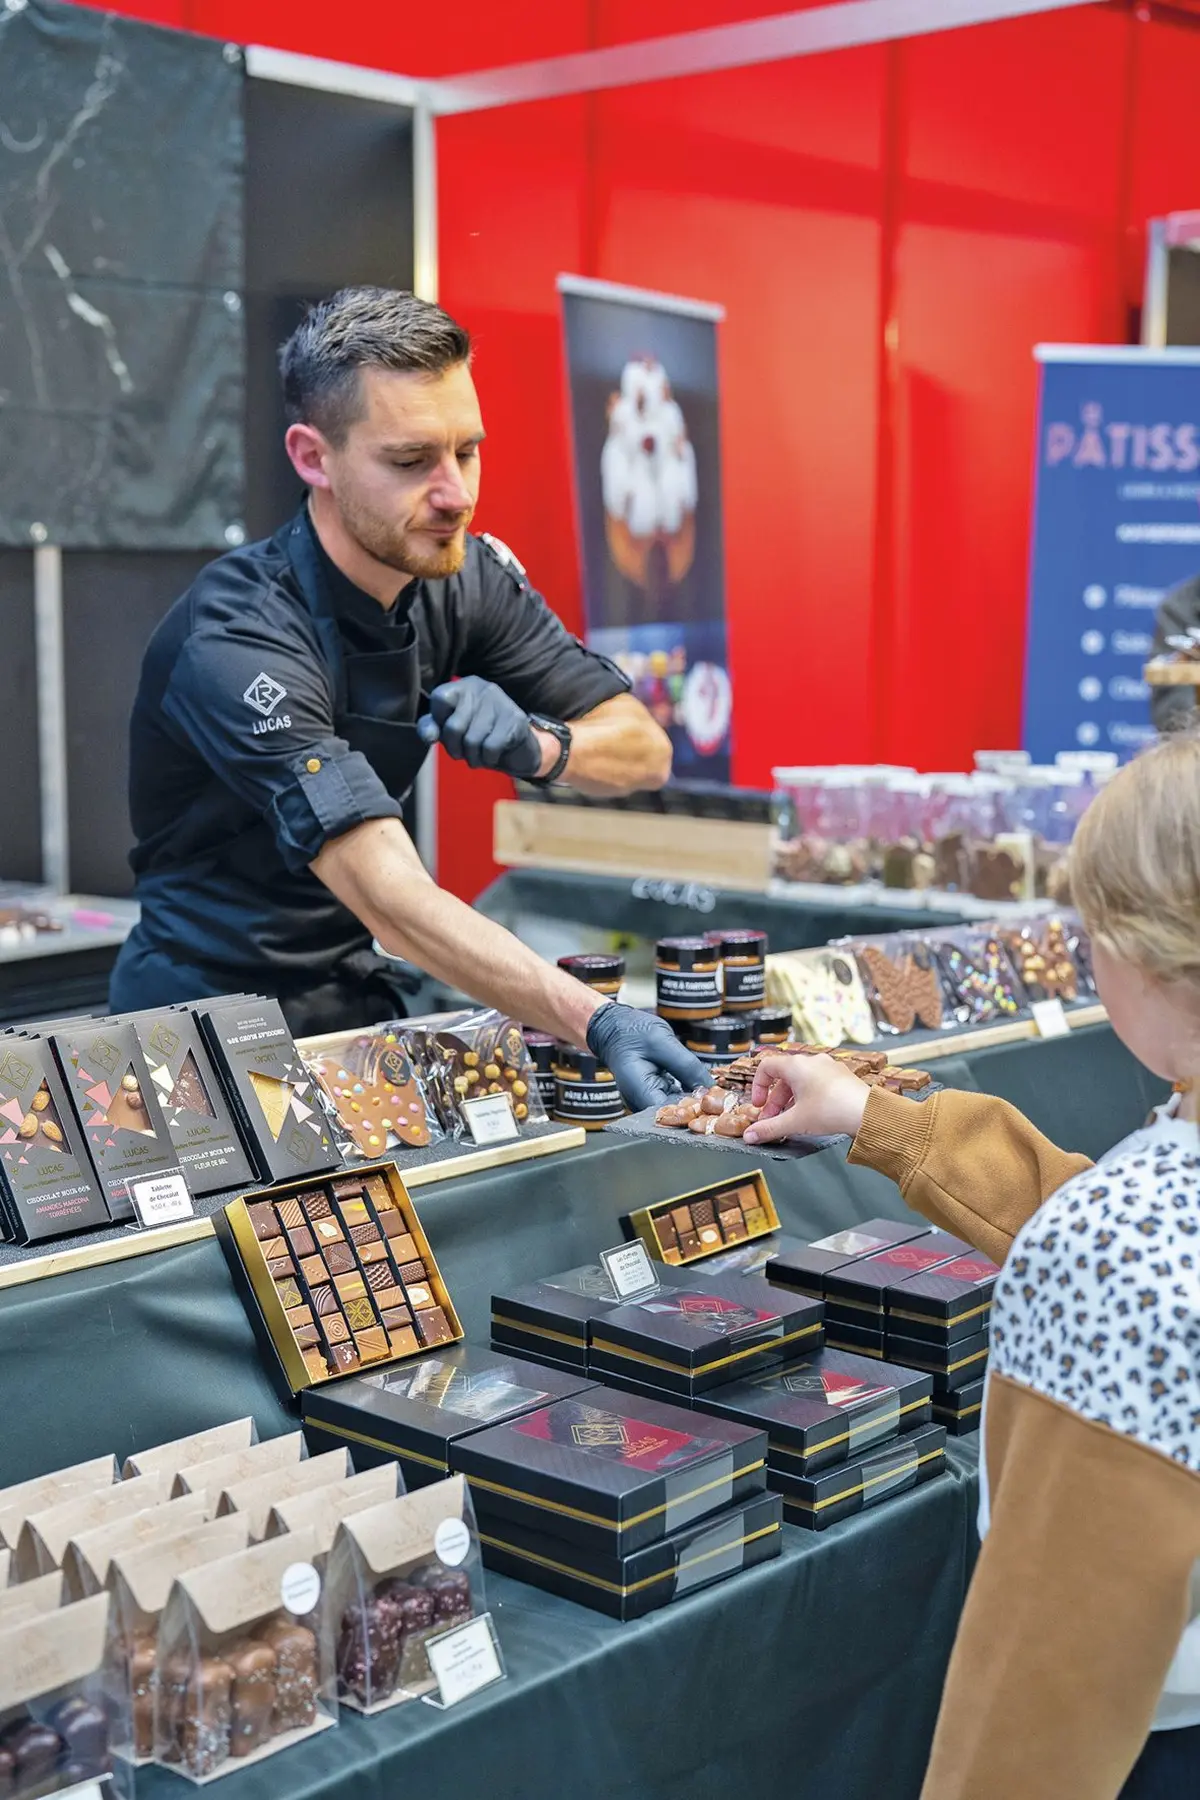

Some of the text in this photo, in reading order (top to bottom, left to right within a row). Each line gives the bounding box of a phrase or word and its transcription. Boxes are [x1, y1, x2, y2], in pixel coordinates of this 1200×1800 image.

[252, 714, 292, 735] LUCAS
[123, 1145, 150, 1158] LUCAS
[178, 1151, 209, 1164] CHOCOLAT
[37, 1163, 65, 1176] LUCAS
[194, 1157, 229, 1171] FLEUR DE SEL
[26, 1190, 61, 1205] CHOCOLAT
[61, 1186, 78, 1198] NOIR
[156, 1191, 180, 1202] Chocolat
[35, 1196, 90, 1214] AMANDES MARCONA
